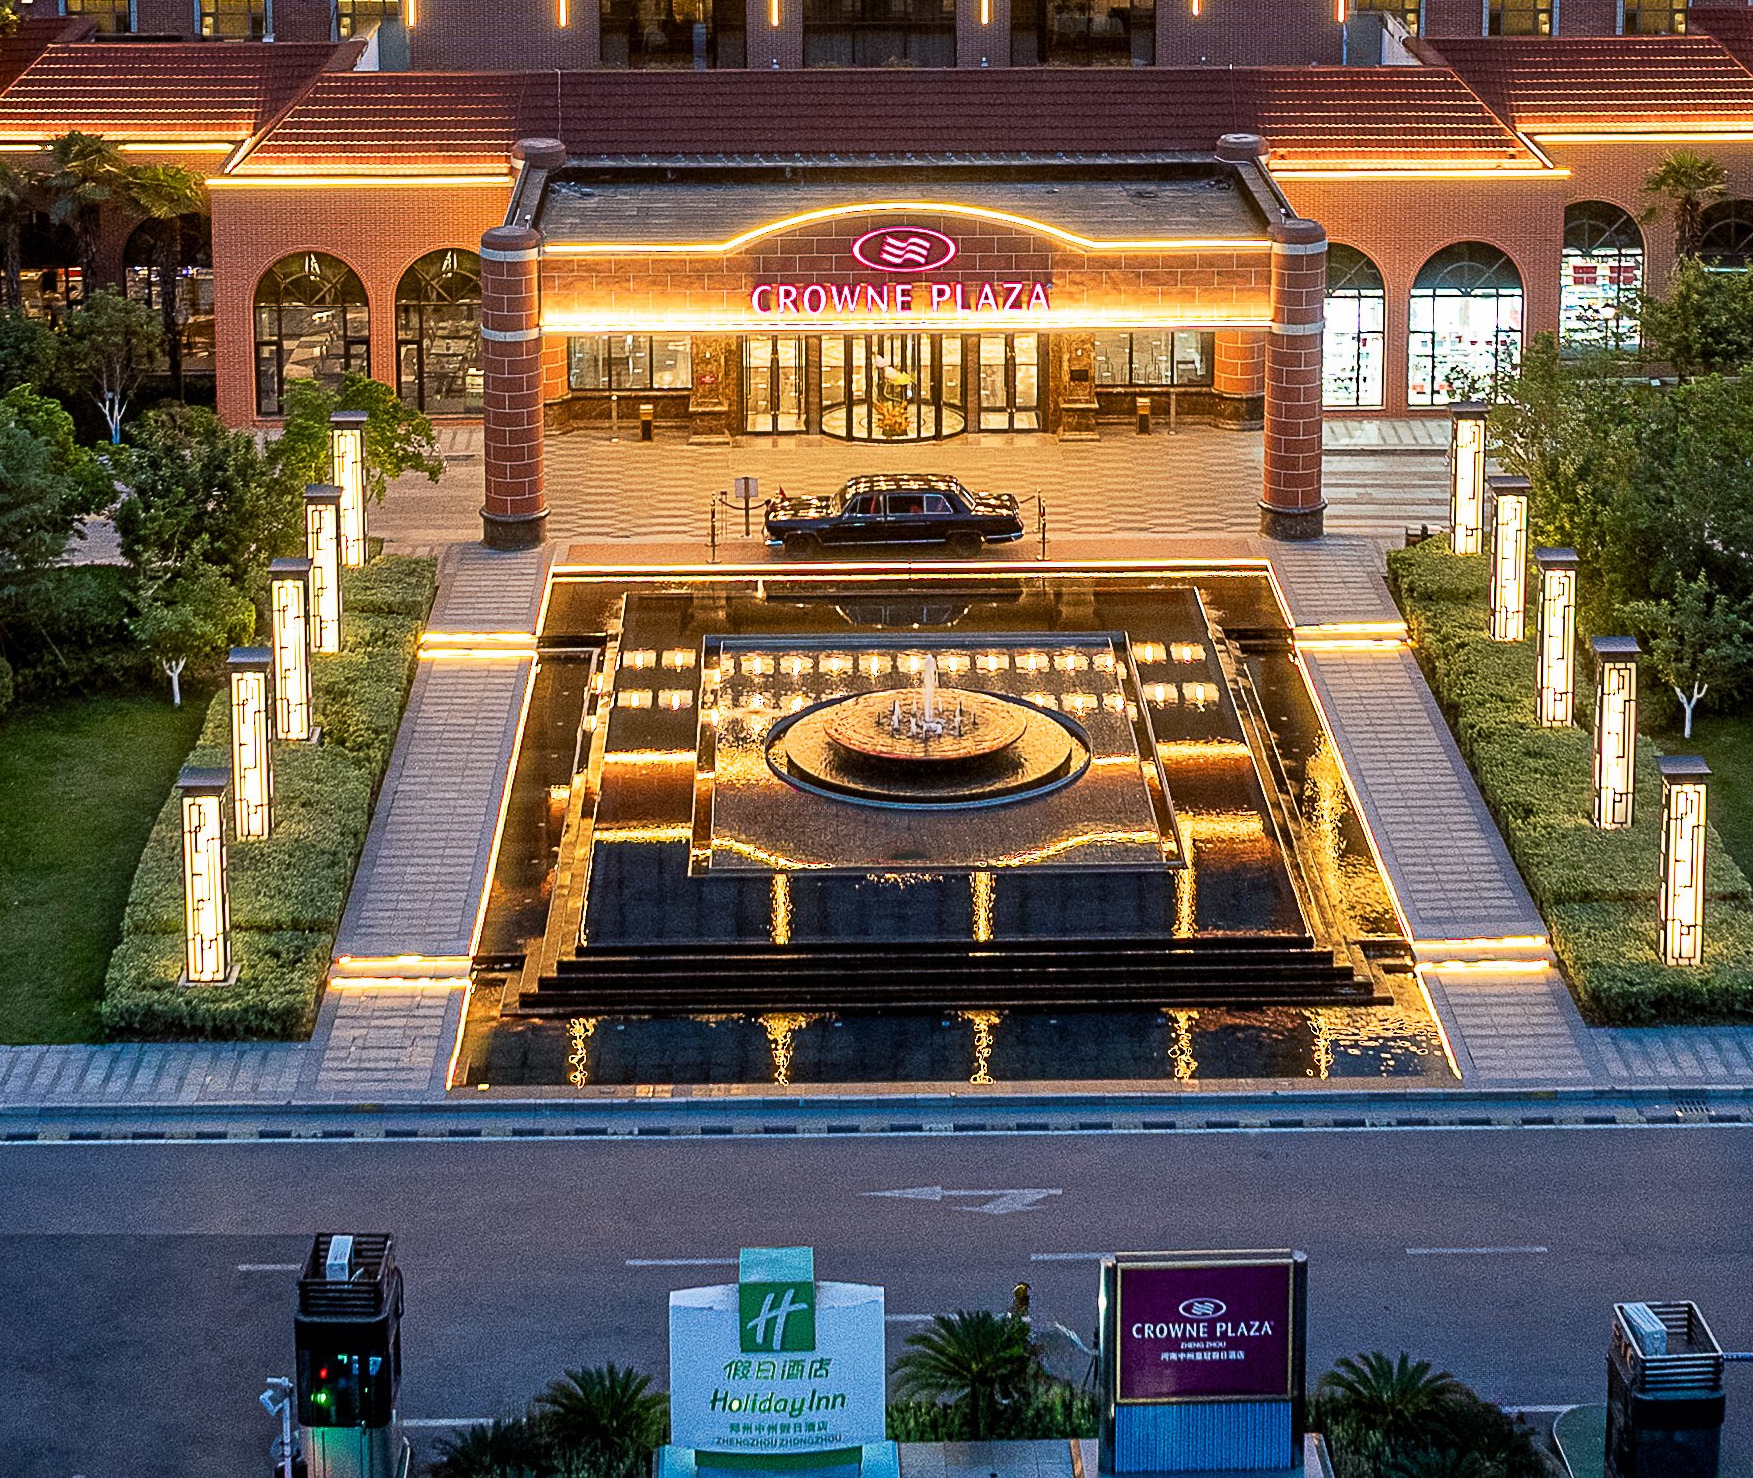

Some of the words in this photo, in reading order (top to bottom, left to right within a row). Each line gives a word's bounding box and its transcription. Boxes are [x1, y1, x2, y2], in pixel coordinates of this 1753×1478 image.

[751, 283, 913, 314] CROWNE
[930, 281, 1051, 313] PLAZA
[1132, 1322, 1208, 1339] CROWNE
[1216, 1321, 1273, 1337] PLAZA
[723, 1358, 832, 1380] 假日酒店
[710, 1388, 806, 1418] Holiday
[809, 1389, 847, 1412] Inn
